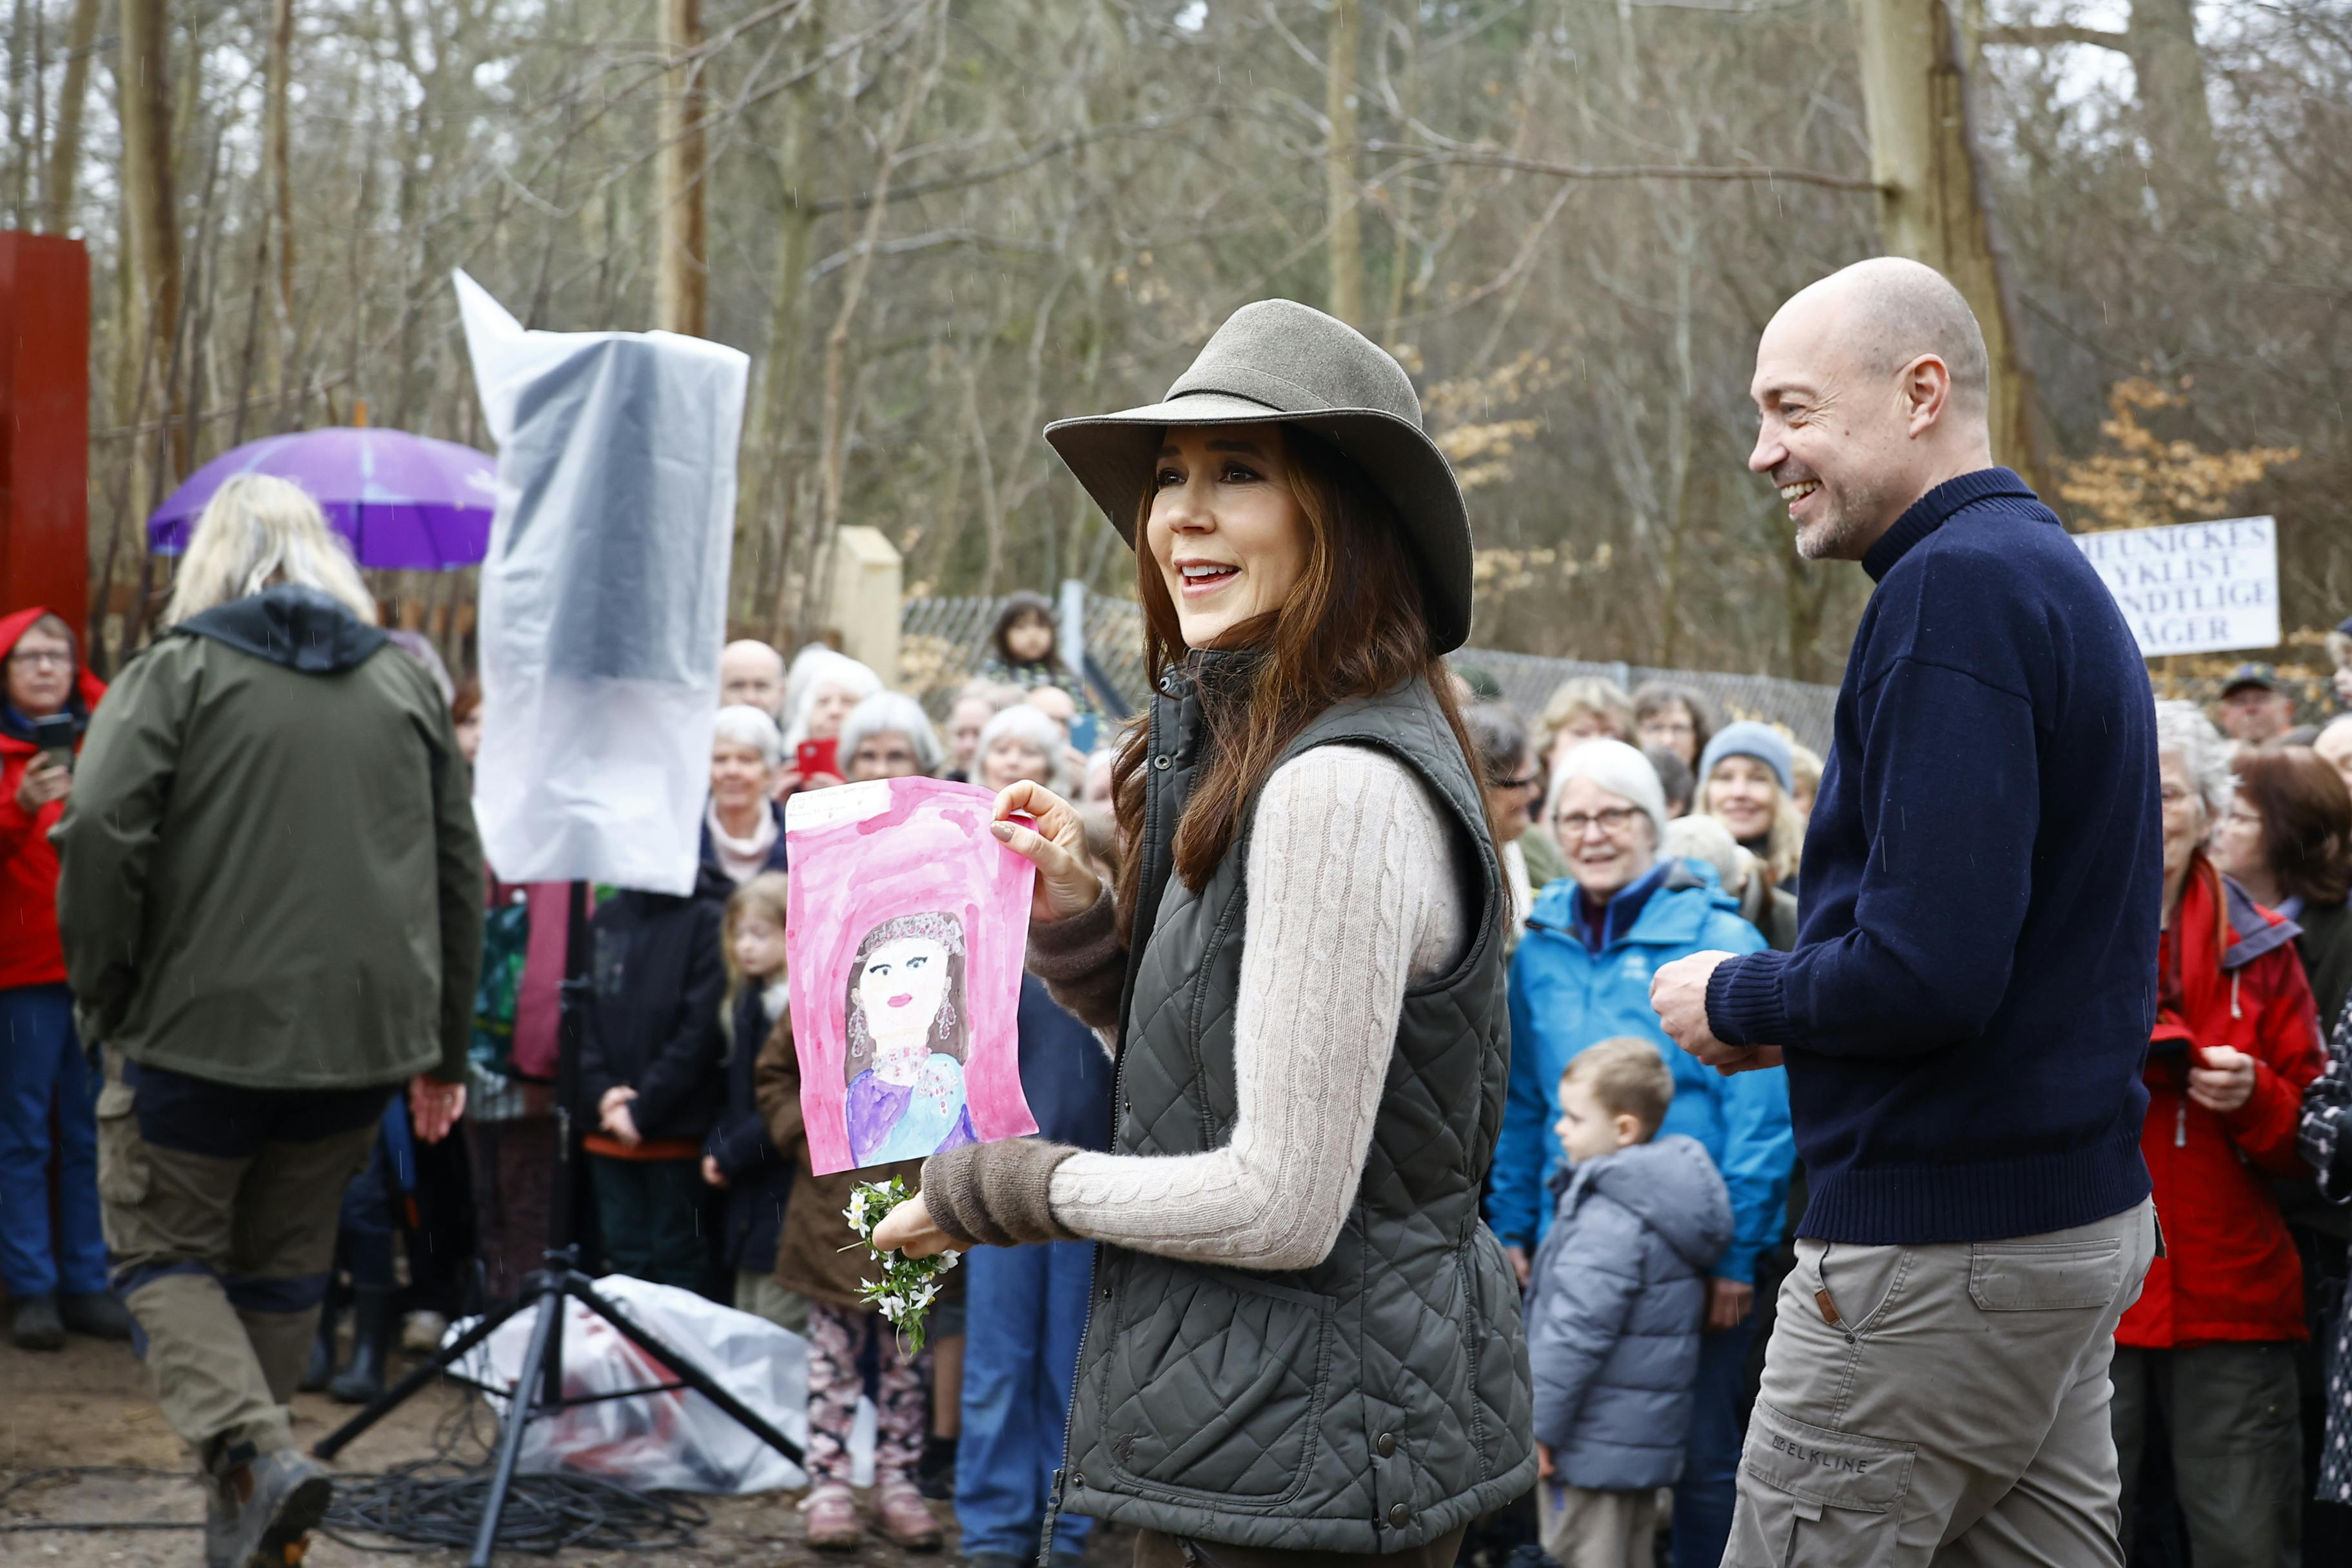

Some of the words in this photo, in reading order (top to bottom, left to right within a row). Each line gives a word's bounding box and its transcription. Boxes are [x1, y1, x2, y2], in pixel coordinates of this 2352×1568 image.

[2113, 556, 2246, 586] YKLIST-
[2122, 582, 2267, 613] NDTLIGE
[2140, 617, 2230, 645] AGER
[1787, 1442, 1867, 1473] ELKLINE
